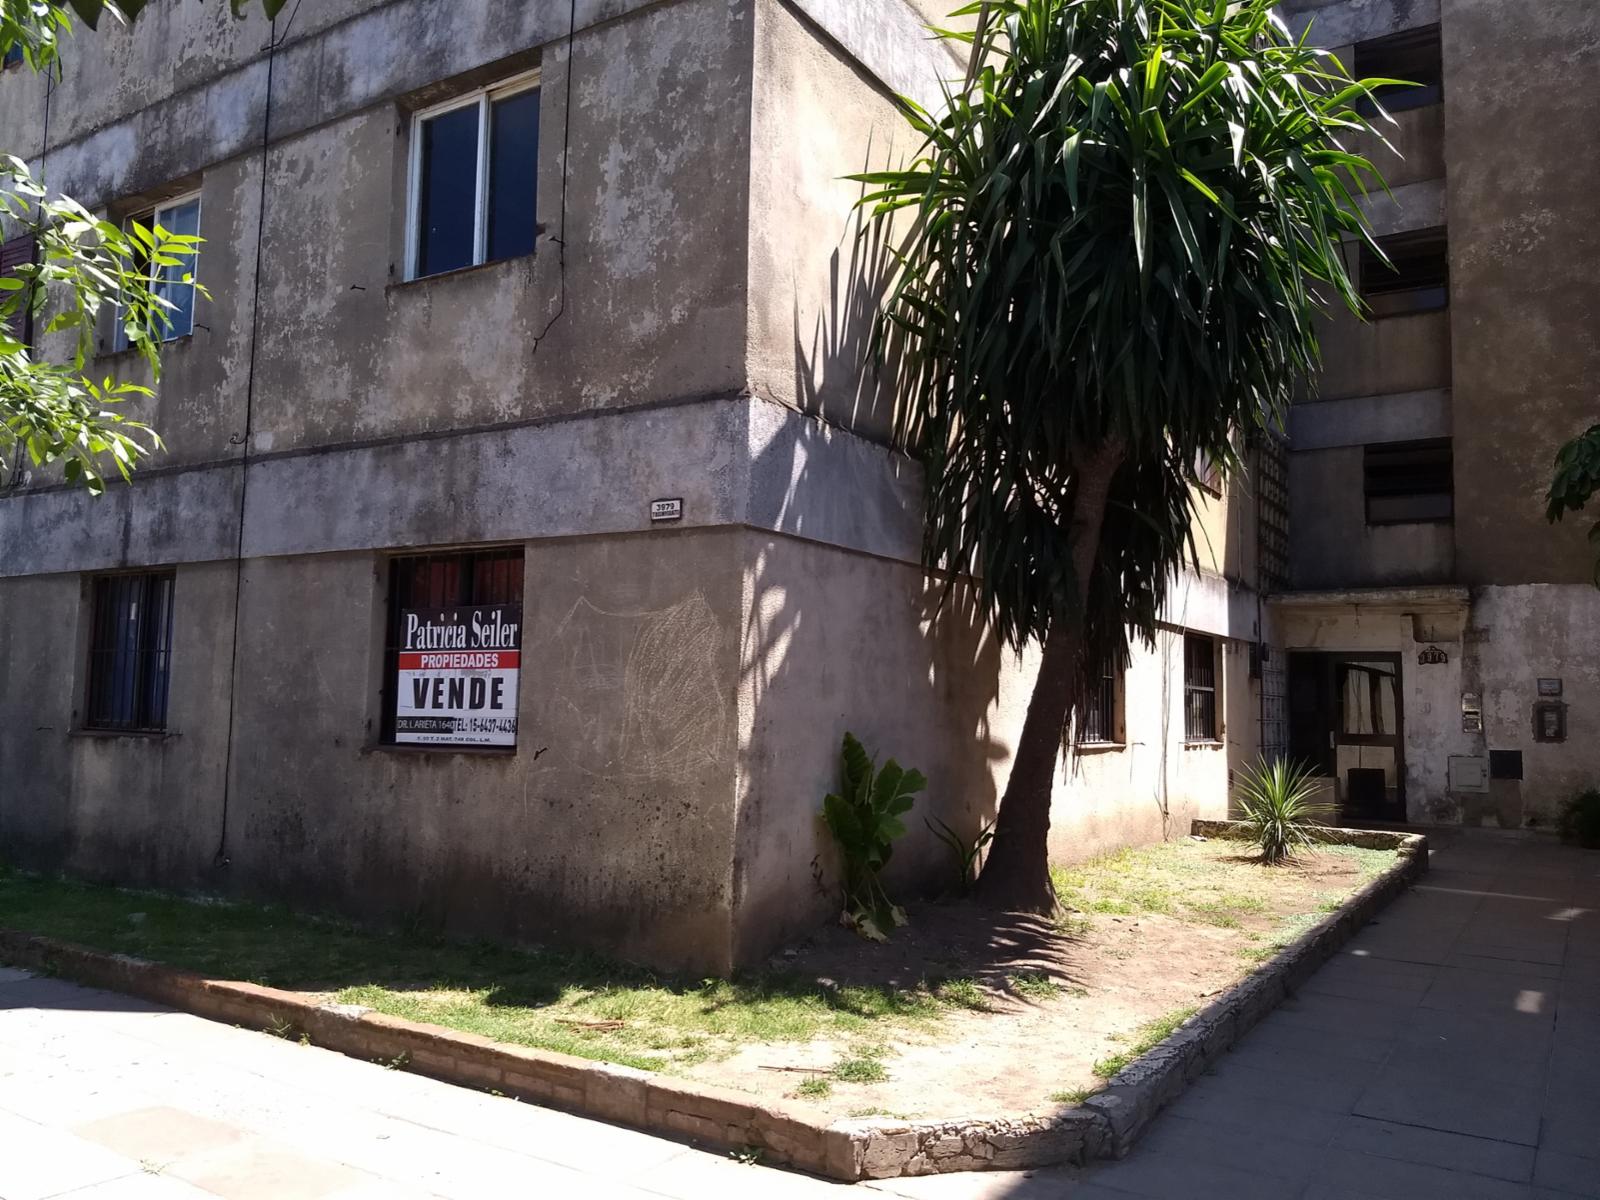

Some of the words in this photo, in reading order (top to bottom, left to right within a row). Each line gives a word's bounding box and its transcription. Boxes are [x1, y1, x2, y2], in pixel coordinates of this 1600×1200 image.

[405, 613, 466, 649] Patricia
[471, 610, 518, 648] Seiler
[421, 653, 499, 668] PROPIEDADES
[413, 677, 504, 710] VENDE
